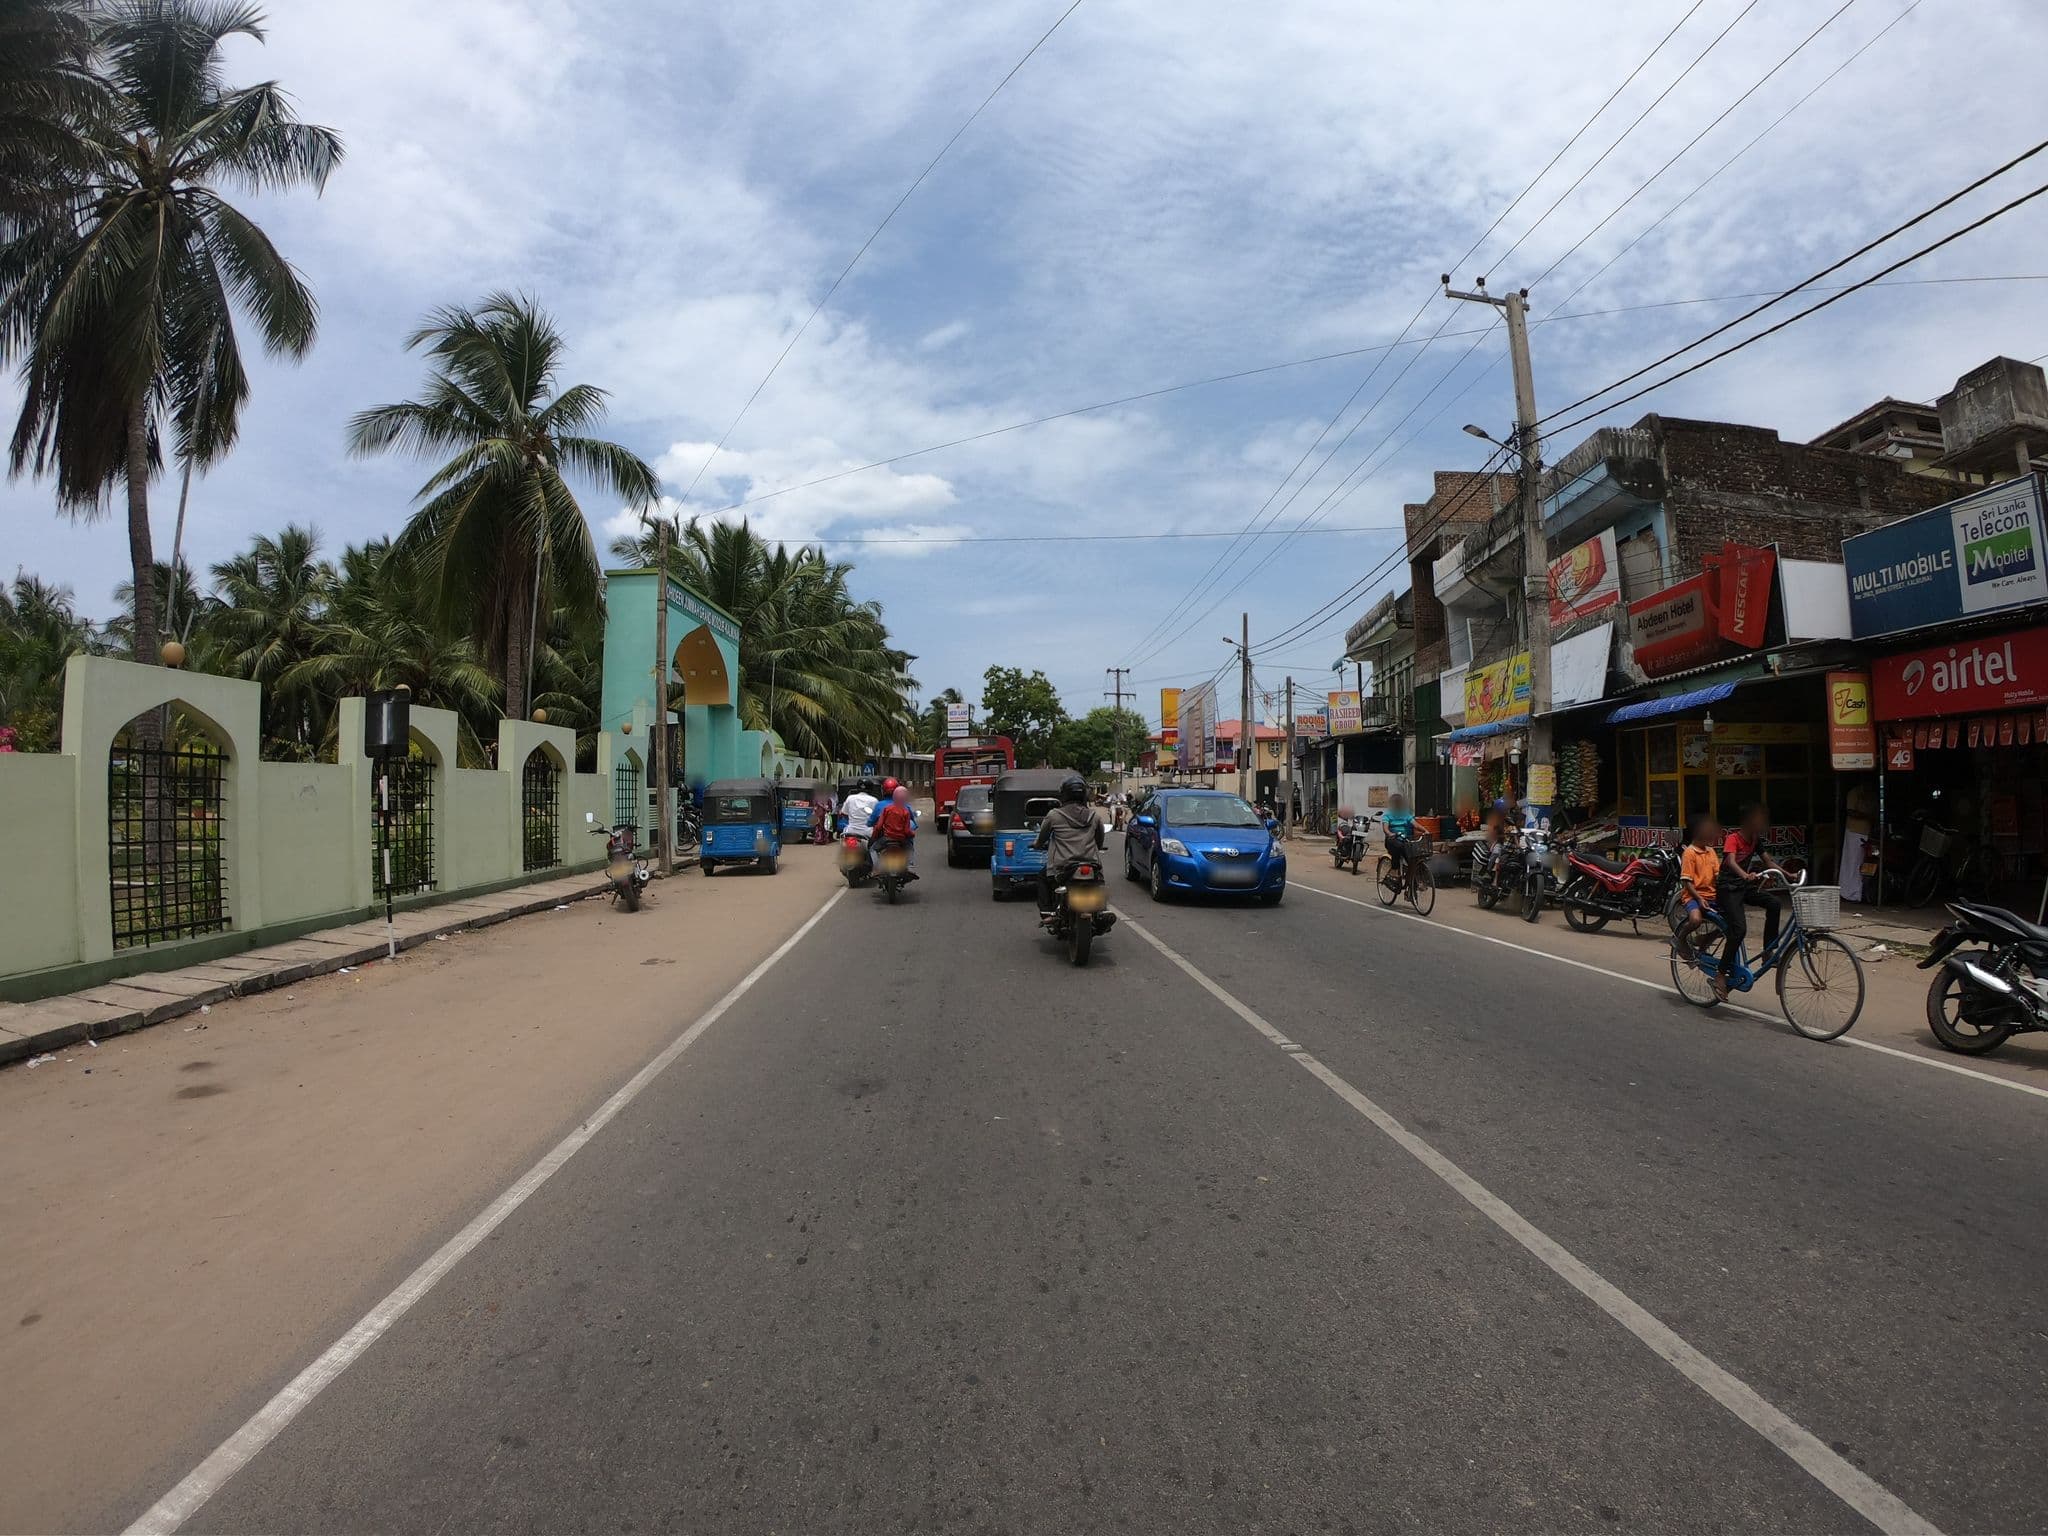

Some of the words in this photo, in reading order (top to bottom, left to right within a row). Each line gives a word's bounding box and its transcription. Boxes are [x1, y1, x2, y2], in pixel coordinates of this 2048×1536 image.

[1981, 507, 1995, 521] Sri
[1997, 499, 2026, 516] Lanka
[1960, 511, 2029, 543] Telecom
[1852, 566, 1893, 594] MULTI
[1895, 549, 1953, 582] MOBILE
[1971, 545, 2029, 577] Mobitel
[1637, 611, 1669, 631] Abdeen
[1670, 598, 1694, 620] Hotel
[1932, 640, 2017, 693] airtel
[1329, 707, 1361, 719] RASHEED
[1846, 698, 1866, 708] Cash
[1296, 715, 1325, 725] ROOMS
[1334, 719, 1356, 729] GROUP
[1891, 750, 1911, 768] 4G
